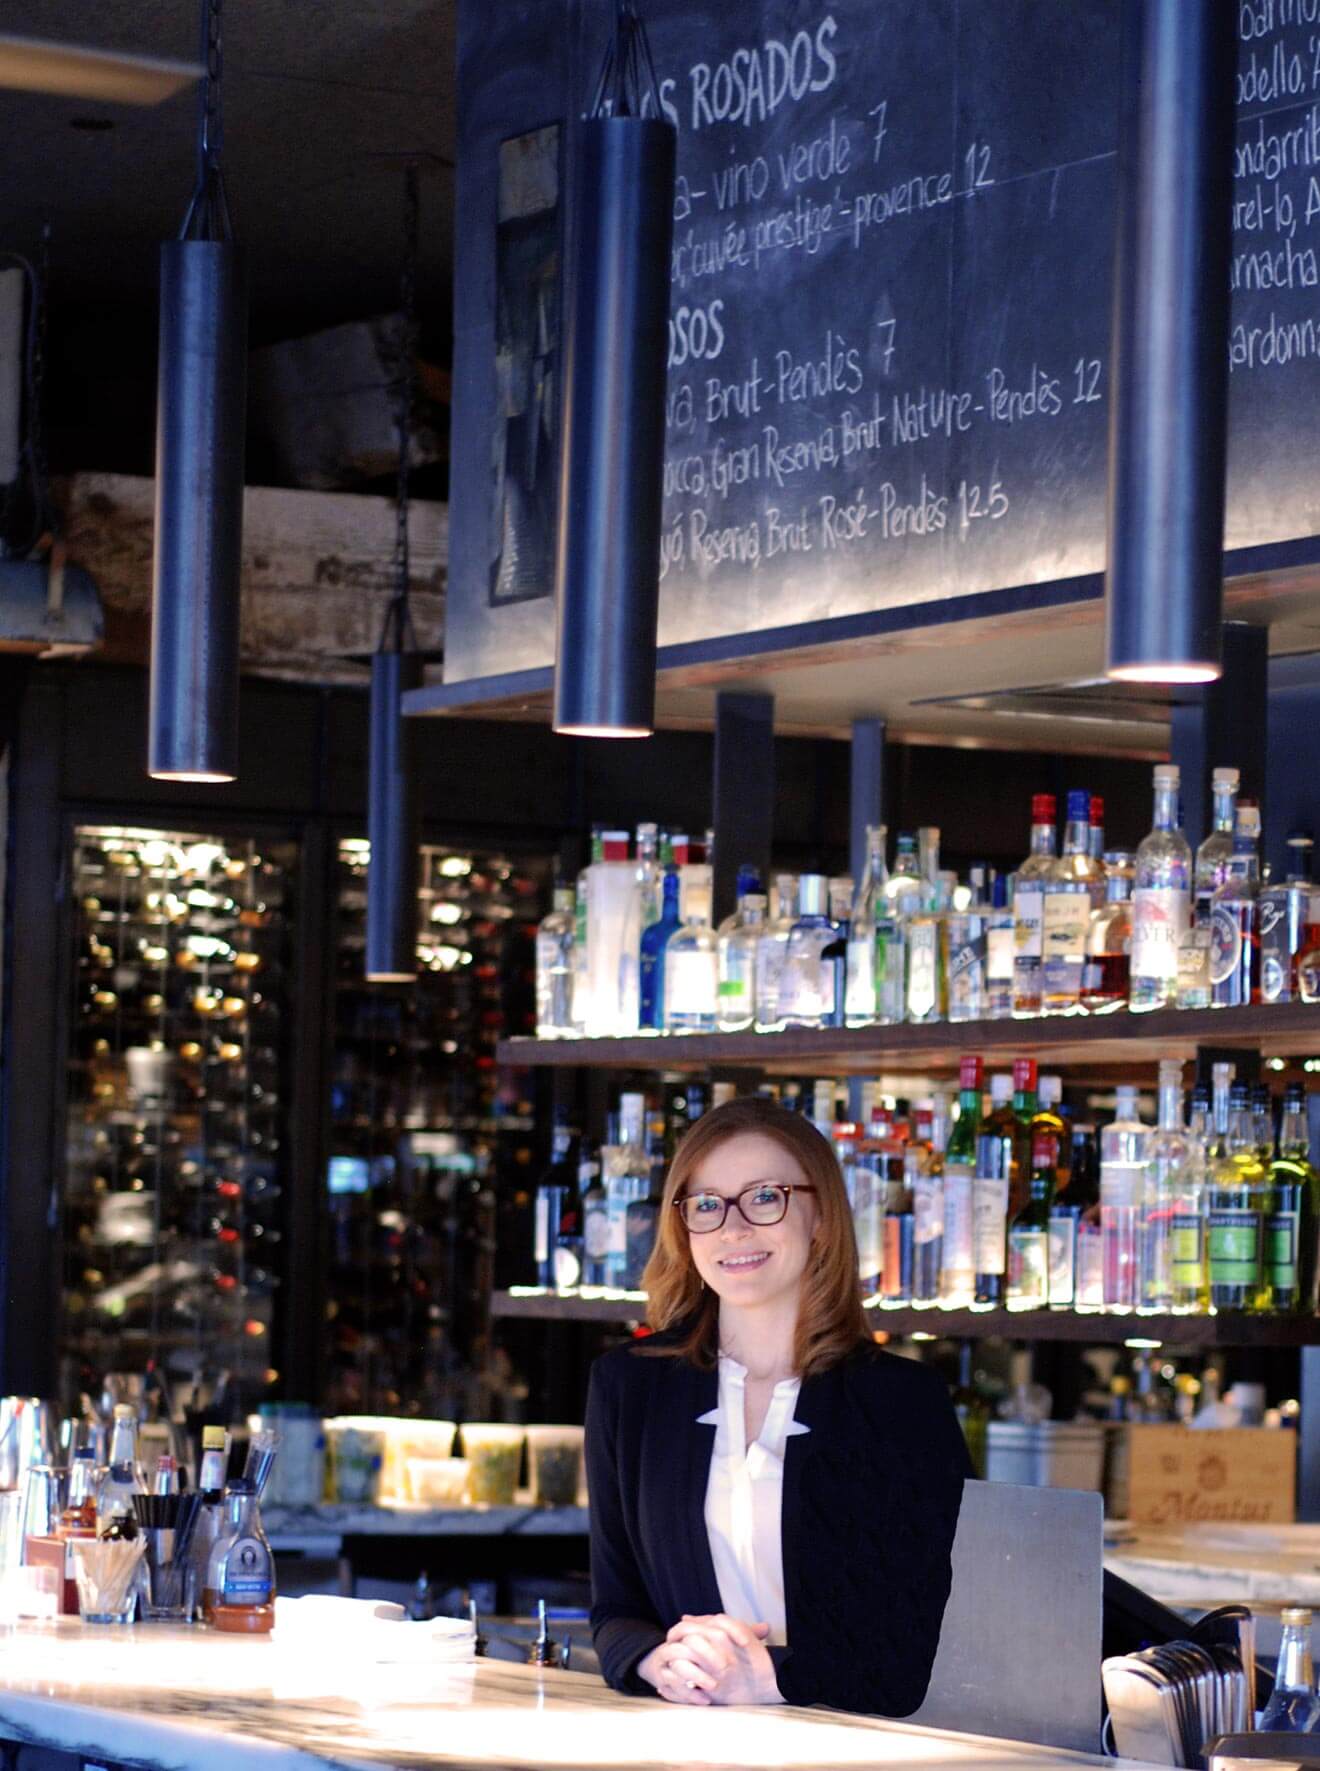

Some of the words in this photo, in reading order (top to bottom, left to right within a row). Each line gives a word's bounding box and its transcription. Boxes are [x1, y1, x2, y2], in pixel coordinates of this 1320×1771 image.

[689, 15, 838, 130] ROSADOS
[713, 145, 769, 211] vino
[779, 117, 850, 190] verde
[868, 101, 888, 163] 7
[965, 142, 995, 187] 12
[1231, 238, 1318, 289] rnacha
[876, 319, 896, 375] 7
[712, 438, 760, 498] Gran
[841, 392, 886, 455] Brut
[1072, 358, 1102, 404] 12
[765, 506, 812, 558] Brut
[958, 480, 1009, 529] 12.5
